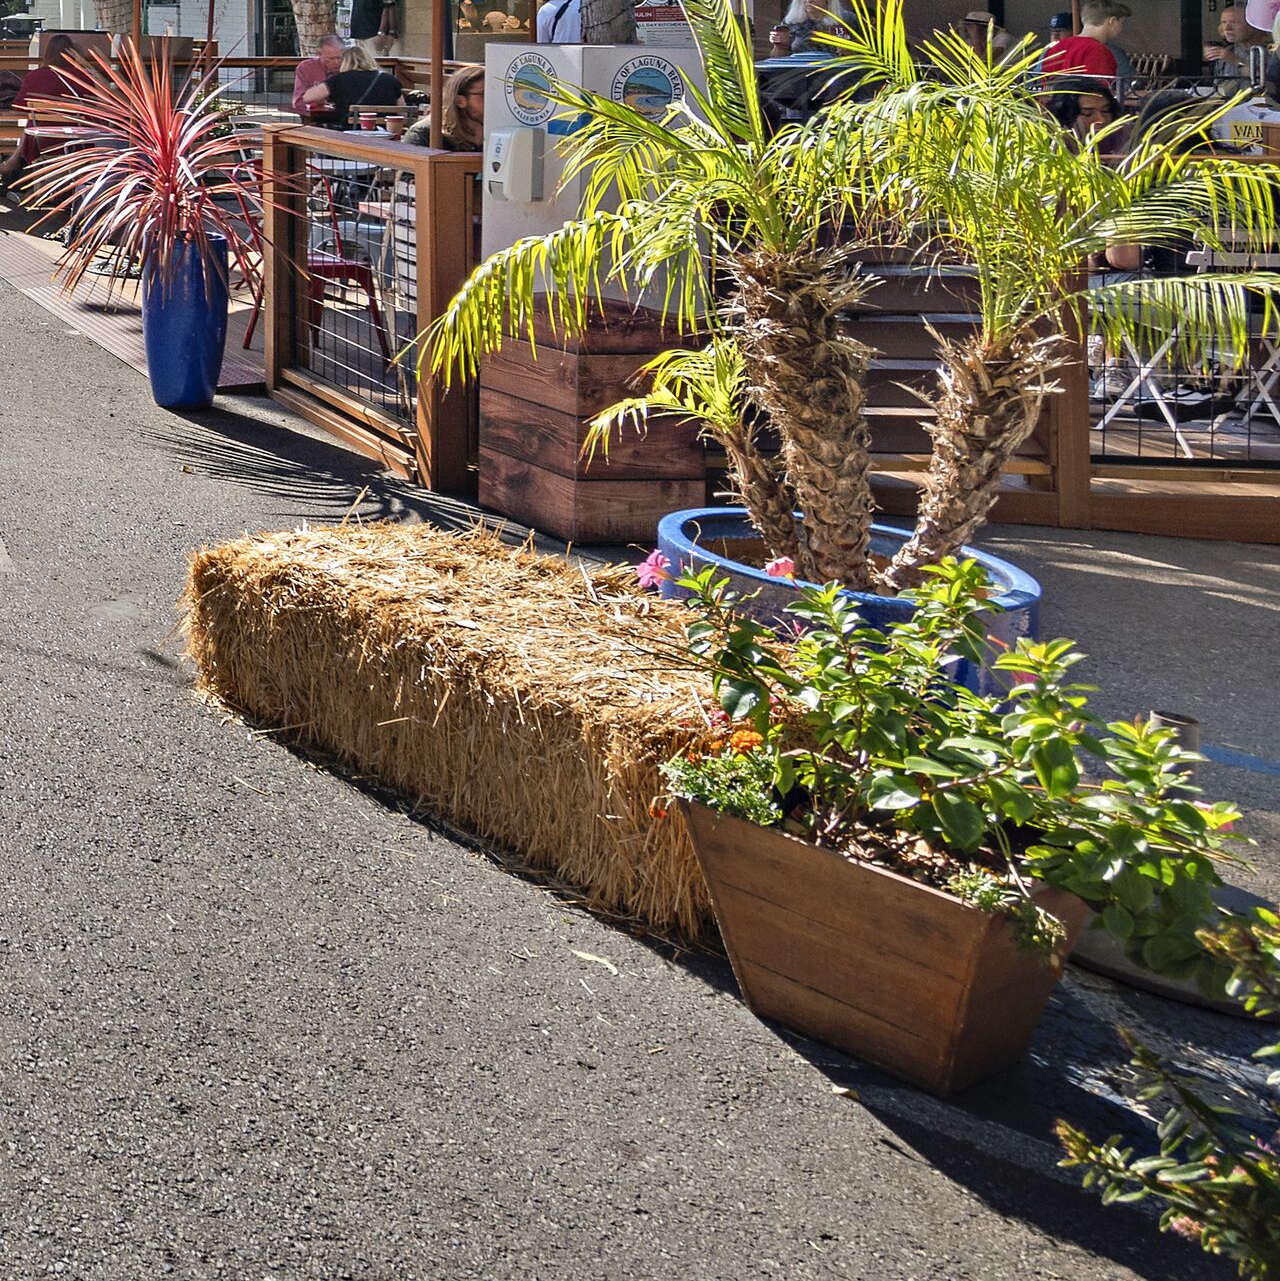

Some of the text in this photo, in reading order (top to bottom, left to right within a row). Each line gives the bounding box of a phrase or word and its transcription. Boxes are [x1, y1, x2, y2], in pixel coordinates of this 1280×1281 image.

[835, 27, 844, 35] 13
[613, 57, 682, 101] CITY OF LAGUNA BEACH
[1234, 125, 1263, 138] WAN
